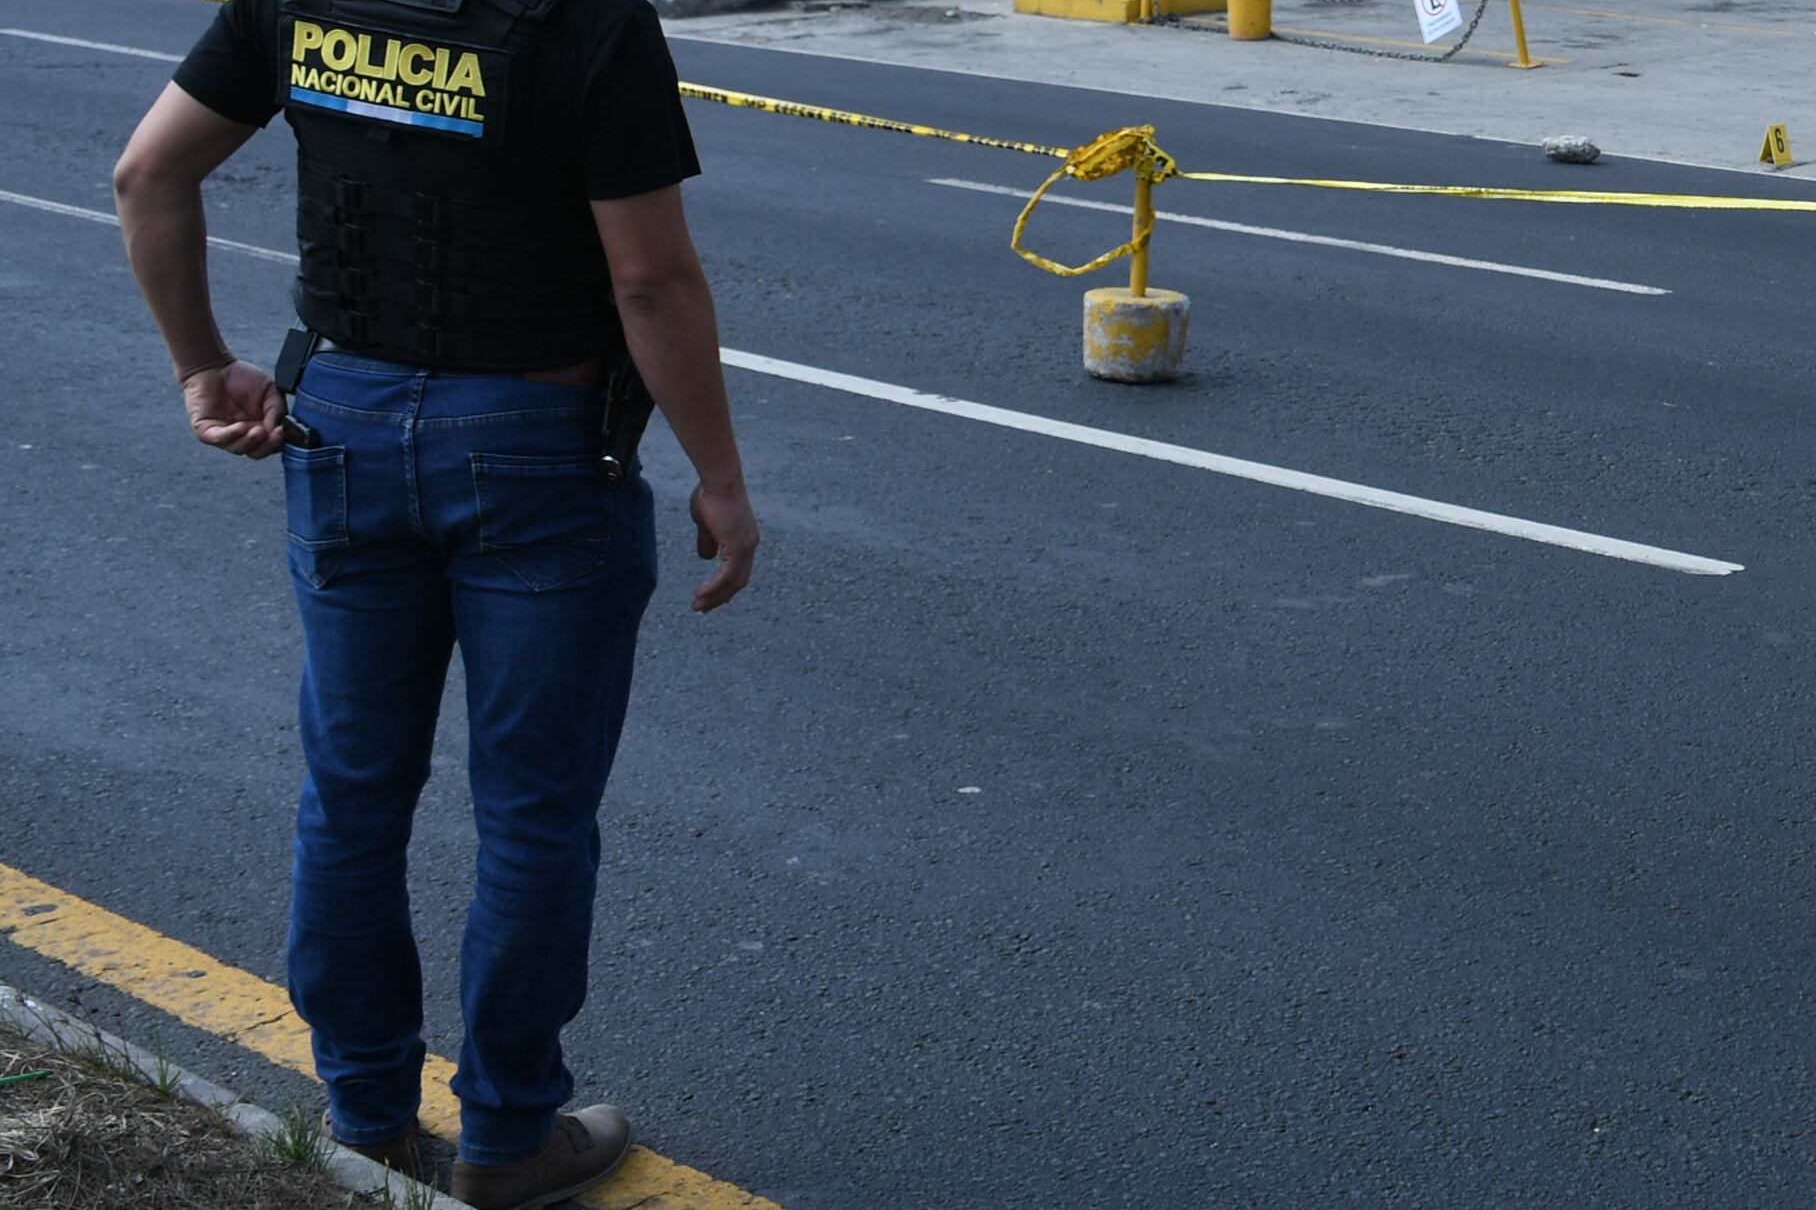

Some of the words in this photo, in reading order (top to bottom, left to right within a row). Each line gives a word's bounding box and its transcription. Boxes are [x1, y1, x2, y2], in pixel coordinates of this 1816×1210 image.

[292, 20, 486, 97] POLICIA
[291, 63, 411, 108] NACIONAL
[415, 89, 485, 121] CIVIL
[1774, 127, 1785, 154] 6
